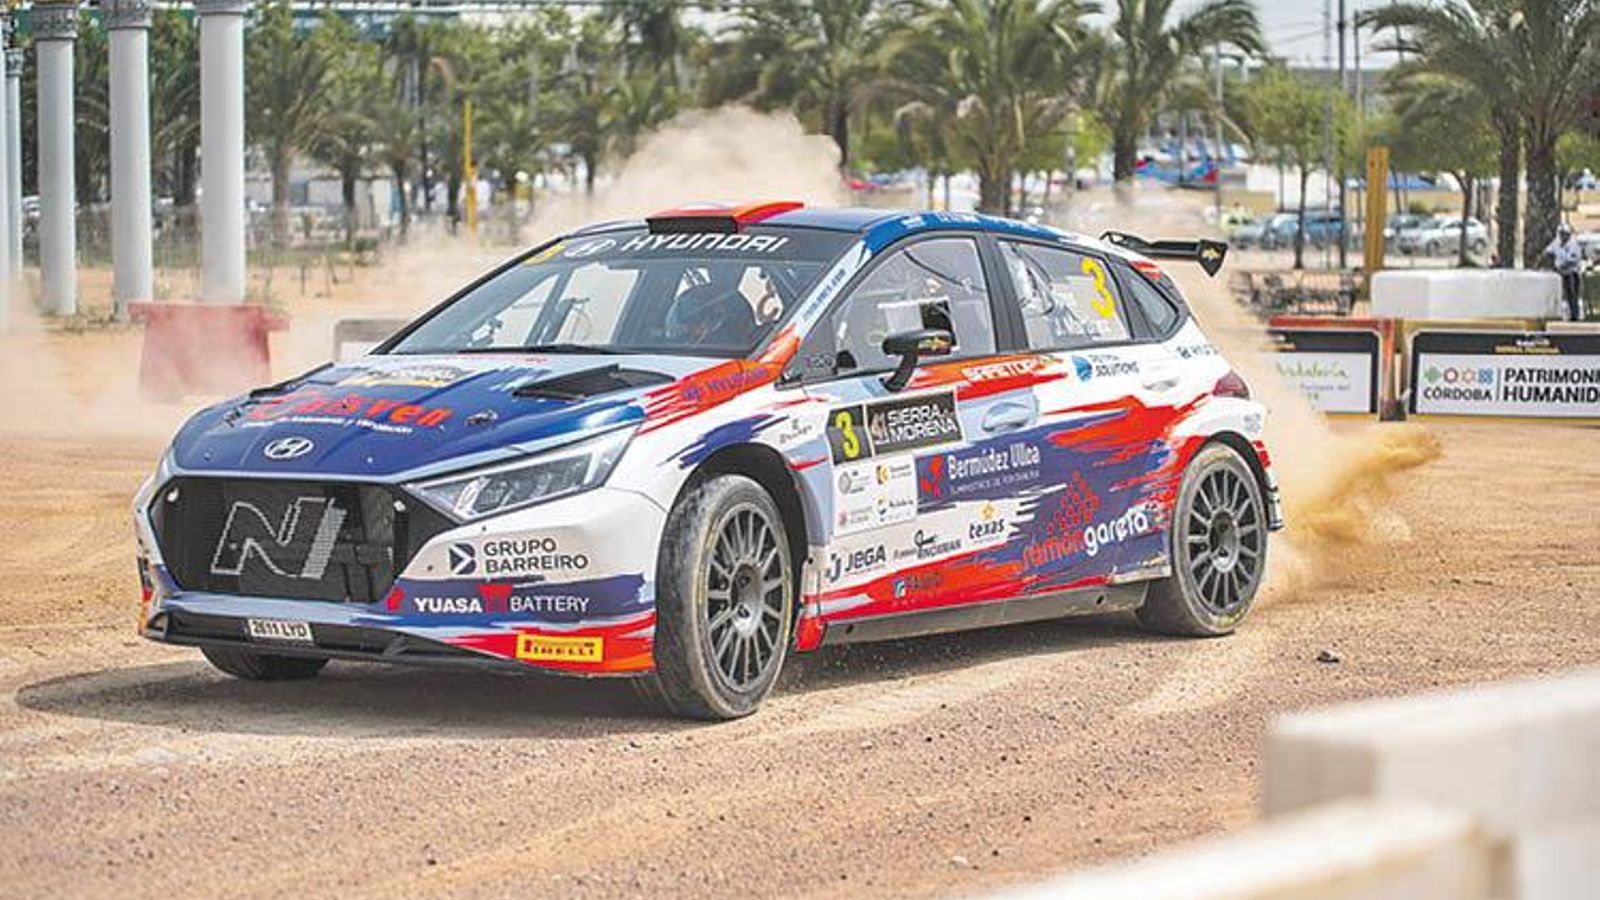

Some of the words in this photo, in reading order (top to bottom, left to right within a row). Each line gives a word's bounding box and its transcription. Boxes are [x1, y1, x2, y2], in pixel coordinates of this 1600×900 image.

[620, 233, 789, 251] HYUNDAI
[1081, 256, 1115, 319] 3
[1423, 385, 1493, 400] CÓRDOBA
[886, 403, 941, 427] SIERRA
[835, 410, 861, 459] 3
[888, 417, 958, 443] MORENA
[969, 517, 1005, 540] texas
[483, 537, 557, 557] GRUPO
[485, 554, 589, 574] BARREIRO
[413, 597, 484, 614] YUASA
[509, 596, 590, 612] BATTERY
